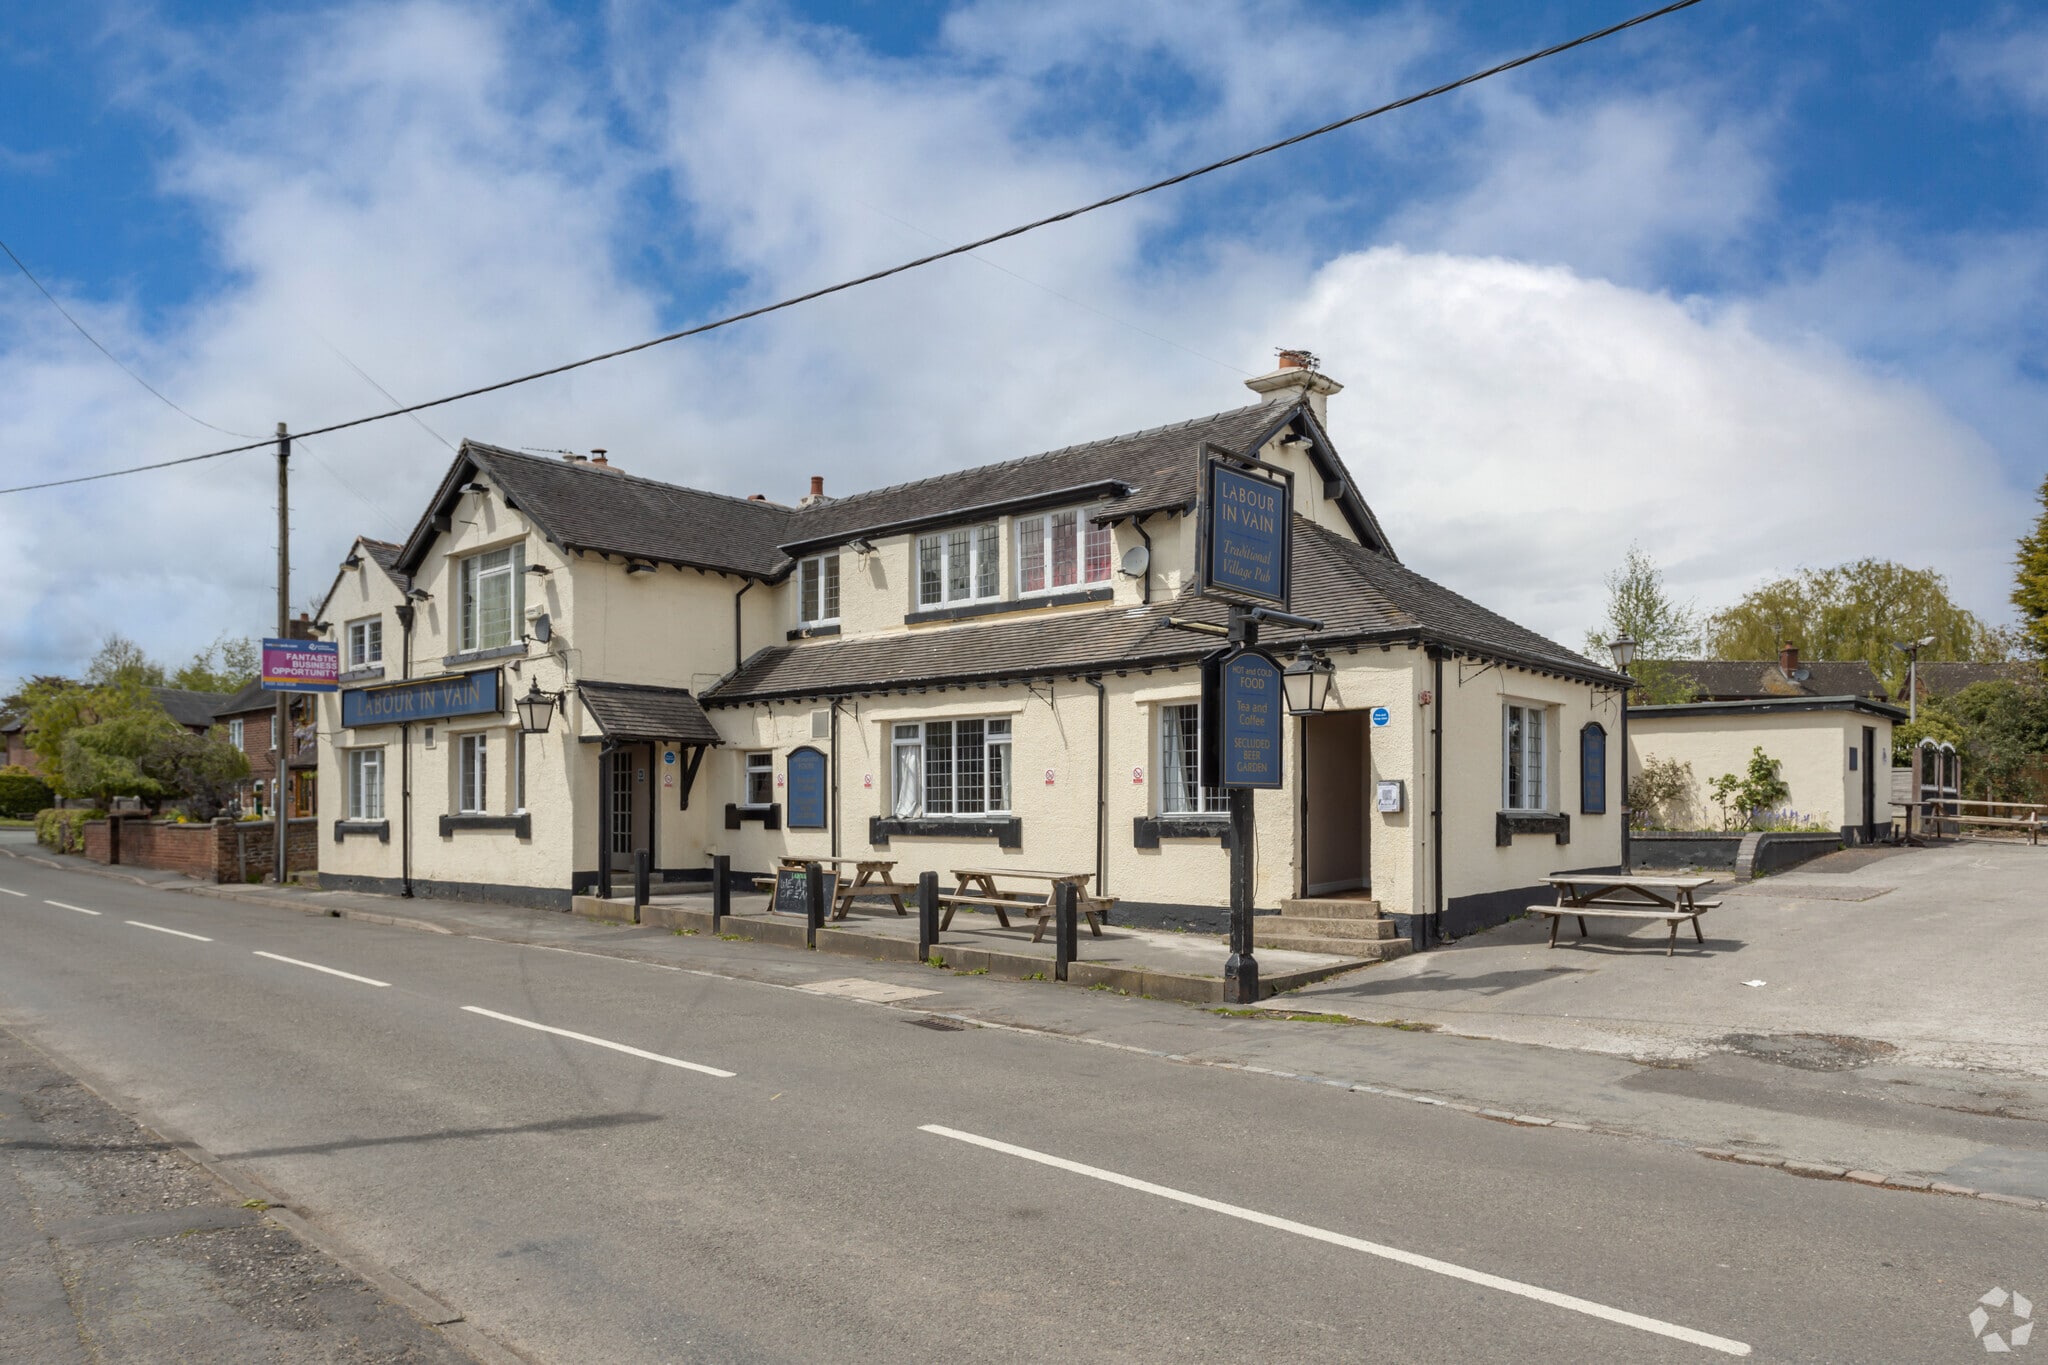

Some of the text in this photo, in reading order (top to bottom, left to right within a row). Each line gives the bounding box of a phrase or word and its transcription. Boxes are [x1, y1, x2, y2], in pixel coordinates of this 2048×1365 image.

[1222, 482, 1274, 512] LABOUR
[1222, 503, 1274, 535] IN VAIN
[1223, 538, 1272, 566] Traditional
[1223, 558, 1271, 583] Village Pub
[286, 653, 337, 663] FANTASTIC
[271, 667, 337, 677] OPPORTUNITY
[292, 661, 337, 670] BUSINESS
[1232, 665, 1273, 677] HOT and COLD
[1240, 677, 1265, 690] FOOD
[356, 679, 481, 717] LABOUR IN VAIN
[1237, 700, 1268, 713] Tea and
[1239, 714, 1266, 727] Coffee
[1234, 738, 1270, 750] SECLUDED
[1243, 750, 1261, 761] BEER
[1237, 762, 1267, 773] GARDEN
